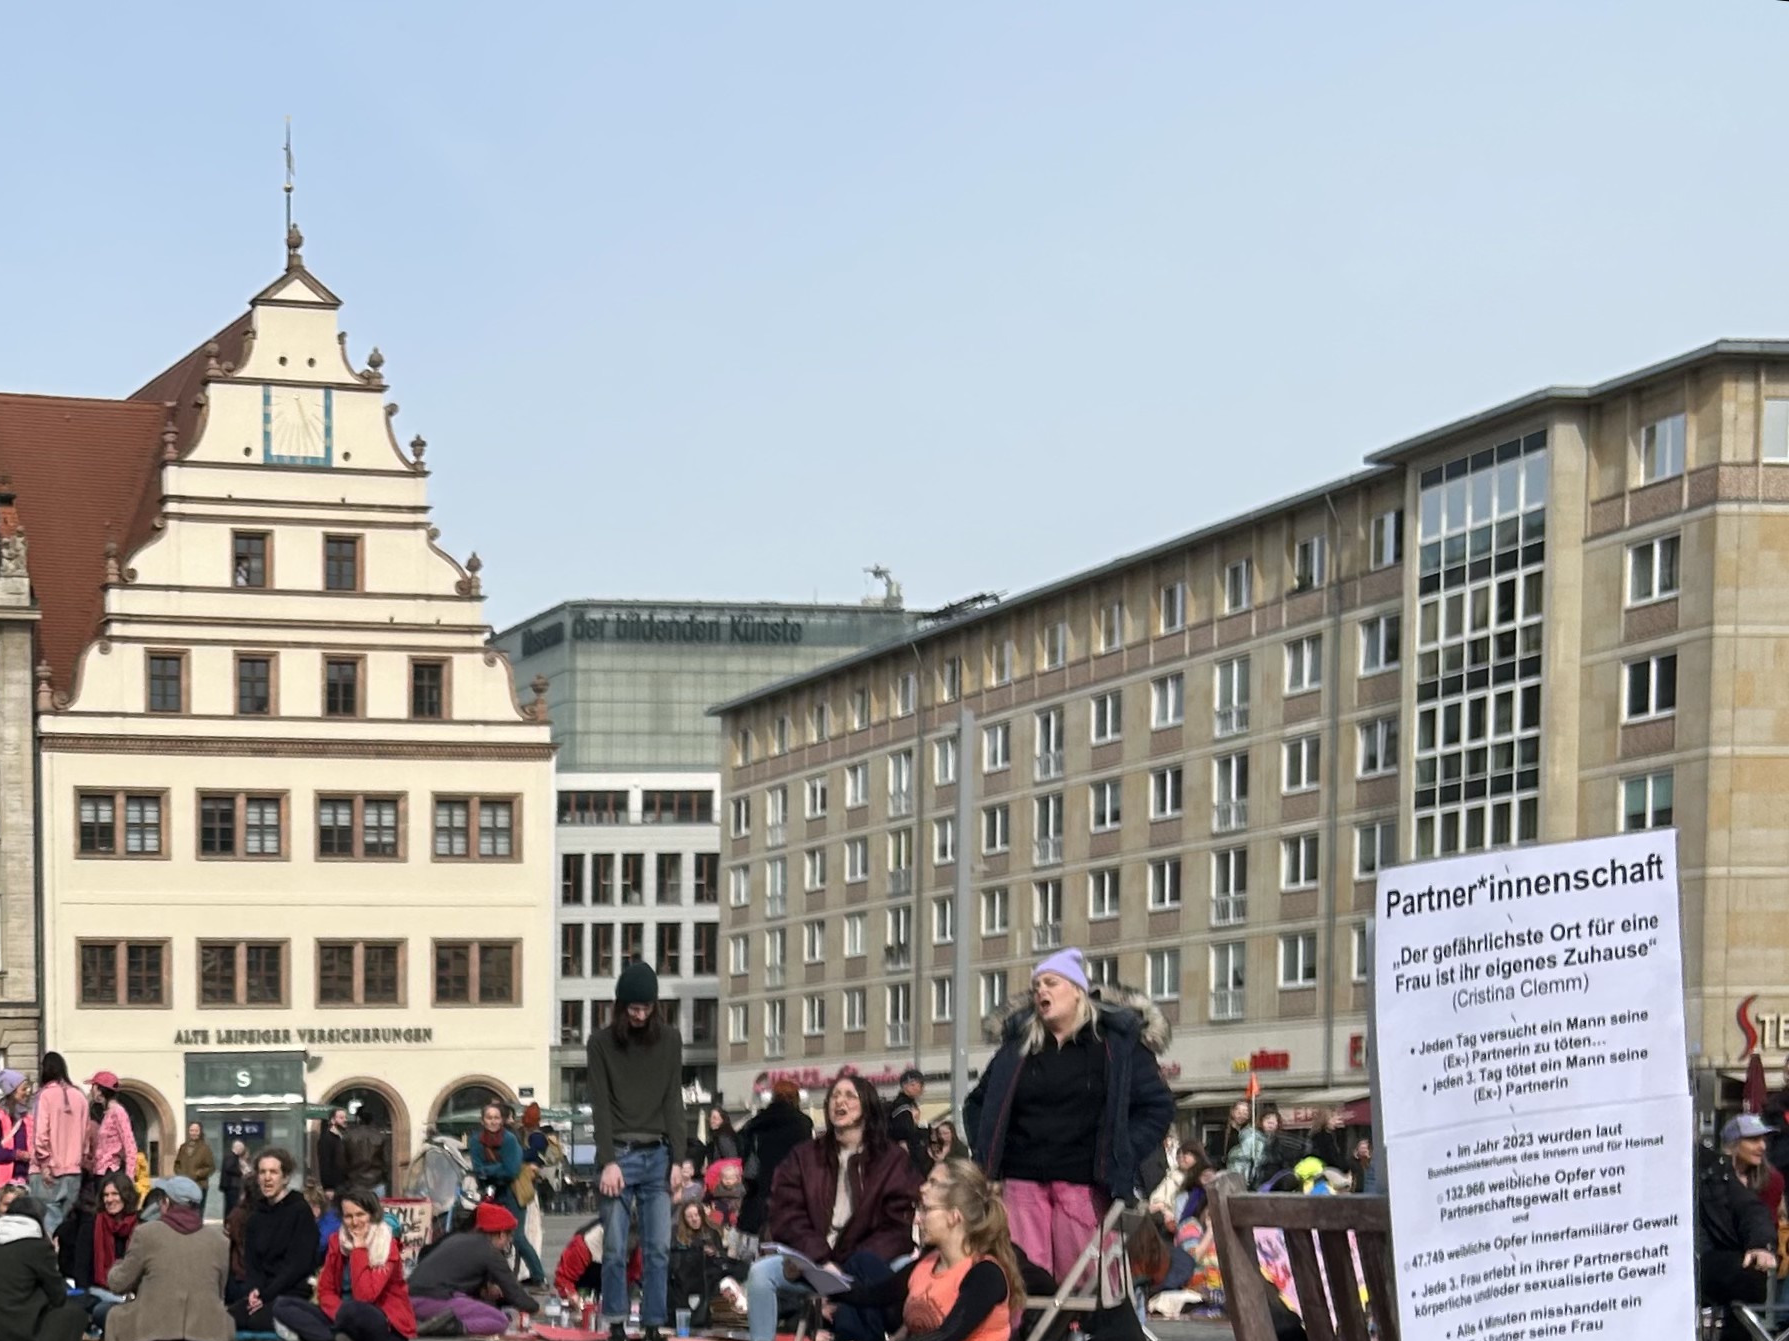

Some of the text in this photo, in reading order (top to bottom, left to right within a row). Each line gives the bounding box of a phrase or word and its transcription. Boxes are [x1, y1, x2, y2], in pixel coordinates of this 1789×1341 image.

[571, 612, 605, 641] der
[615, 612, 721, 642] bildenden
[730, 613, 802, 643] Künste
[1433, 927, 1544, 964] gefährlichste
[1551, 922, 1582, 942] Ort
[1588, 918, 1615, 936] für
[1621, 913, 1659, 932] eine
[1395, 970, 1431, 993] Frau
[1436, 965, 1455, 985] ist
[1460, 963, 1480, 982] ihr
[1486, 953, 1557, 978] eigenes
[1452, 972, 1589, 1013] (Cristina Clemm)
[174, 1029, 209, 1044] ALTE
[298, 1028, 433, 1044] VERSICHERUNGEN
[1456, 1033, 1477, 1051] Tag
[1480, 1023, 1537, 1044] versucht
[1540, 1018, 1562, 1034] ein
[1566, 1014, 1605, 1031] Mann
[1611, 1009, 1649, 1026] seine
[1472, 1041, 1530, 1064] Partnerin
[1534, 1040, 1550, 1054] zu
[1479, 1066, 1502, 1083] Tag
[1506, 1061, 1537, 1077] tötet
[1540, 1057, 1562, 1073] ein
[1566, 1053, 1605, 1069] Mann
[1610, 1048, 1648, 1064] seine
[237, 1071, 252, 1088] S
[1506, 1076, 1568, 1097] Partnerin
[1473, 1139, 1500, 1155] Jahr
[1503, 1132, 1534, 1150] 2023
[1537, 1128, 1592, 1145] wurden
[1596, 1123, 1623, 1138] laut
[1582, 1142, 1603, 1155] und
[1488, 1172, 1551, 1192] weibliche
[1555, 1167, 1596, 1187] Opfer
[1600, 1163, 1626, 1178] von
[1440, 1182, 1622, 1222] Partnerschaftsgewalt erfasst
[1447, 1240, 1491, 1261] weibliche
[1494, 1233, 1528, 1252] Opfer
[1531, 1222, 1630, 1244] innerfamiliärer
[1632, 1213, 1678, 1232] Gewalt
[1421, 1279, 1447, 1298] Jede
[1461, 1272, 1482, 1289] Frau
[1483, 1263, 1516, 1283] erlebt
[1520, 1260, 1532, 1275] in
[1536, 1255, 1570, 1272] ihrer
[1573, 1243, 1669, 1269] Partnerschaft
[1414, 1292, 1472, 1319] körperliche
[1524, 1271, 1612, 1293] sexualisierte
[1617, 1263, 1666, 1281] Gewalt
[1456, 1322, 1476, 1340] Alle
[1530, 1297, 1617, 1321] misshandelt
[1621, 1295, 1642, 1309] ein
[1529, 1324, 1567, 1339] seine
[1571, 1318, 1603, 1335] Frau
